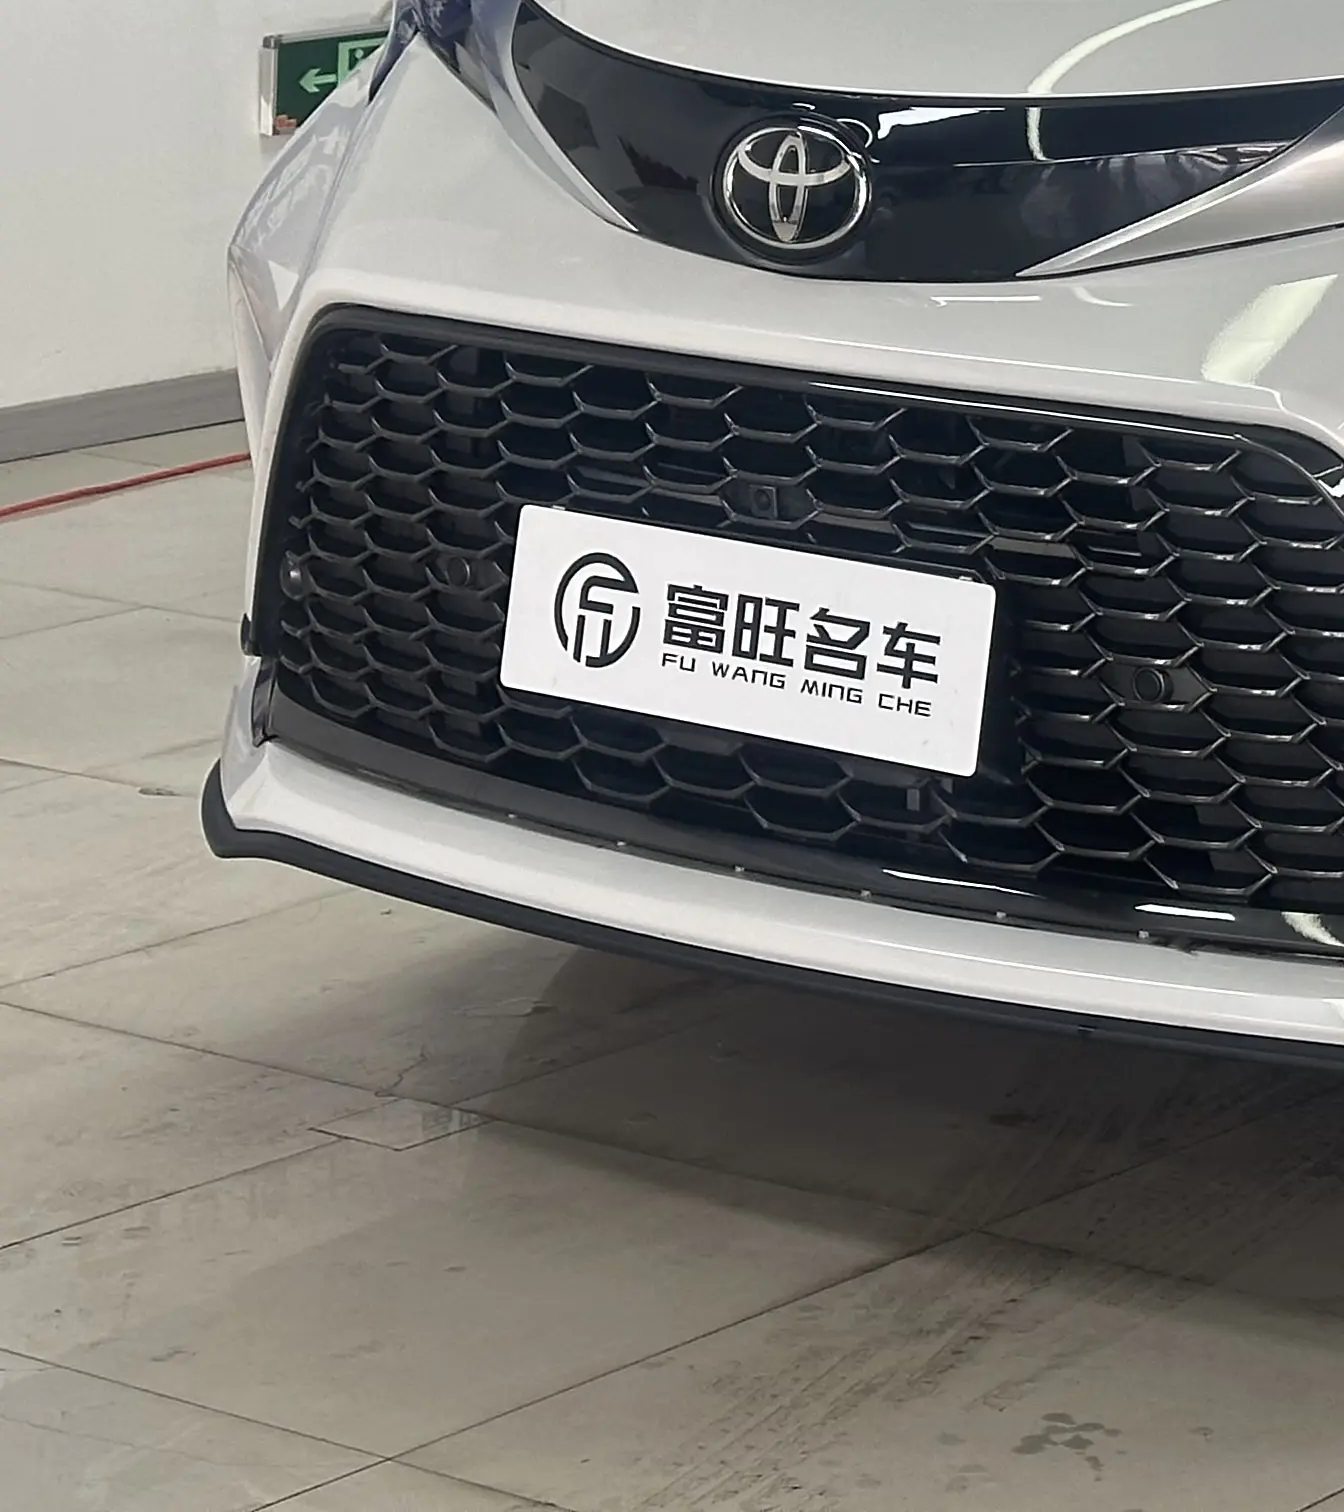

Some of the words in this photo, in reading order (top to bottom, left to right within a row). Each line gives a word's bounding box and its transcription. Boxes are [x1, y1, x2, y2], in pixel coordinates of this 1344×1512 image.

[662, 583, 941, 690] 富旺名车
[661, 652, 696, 673] FU
[711, 661, 787, 690] WANG
[800, 679, 863, 705] MING
[877, 693, 932, 718] CHE
